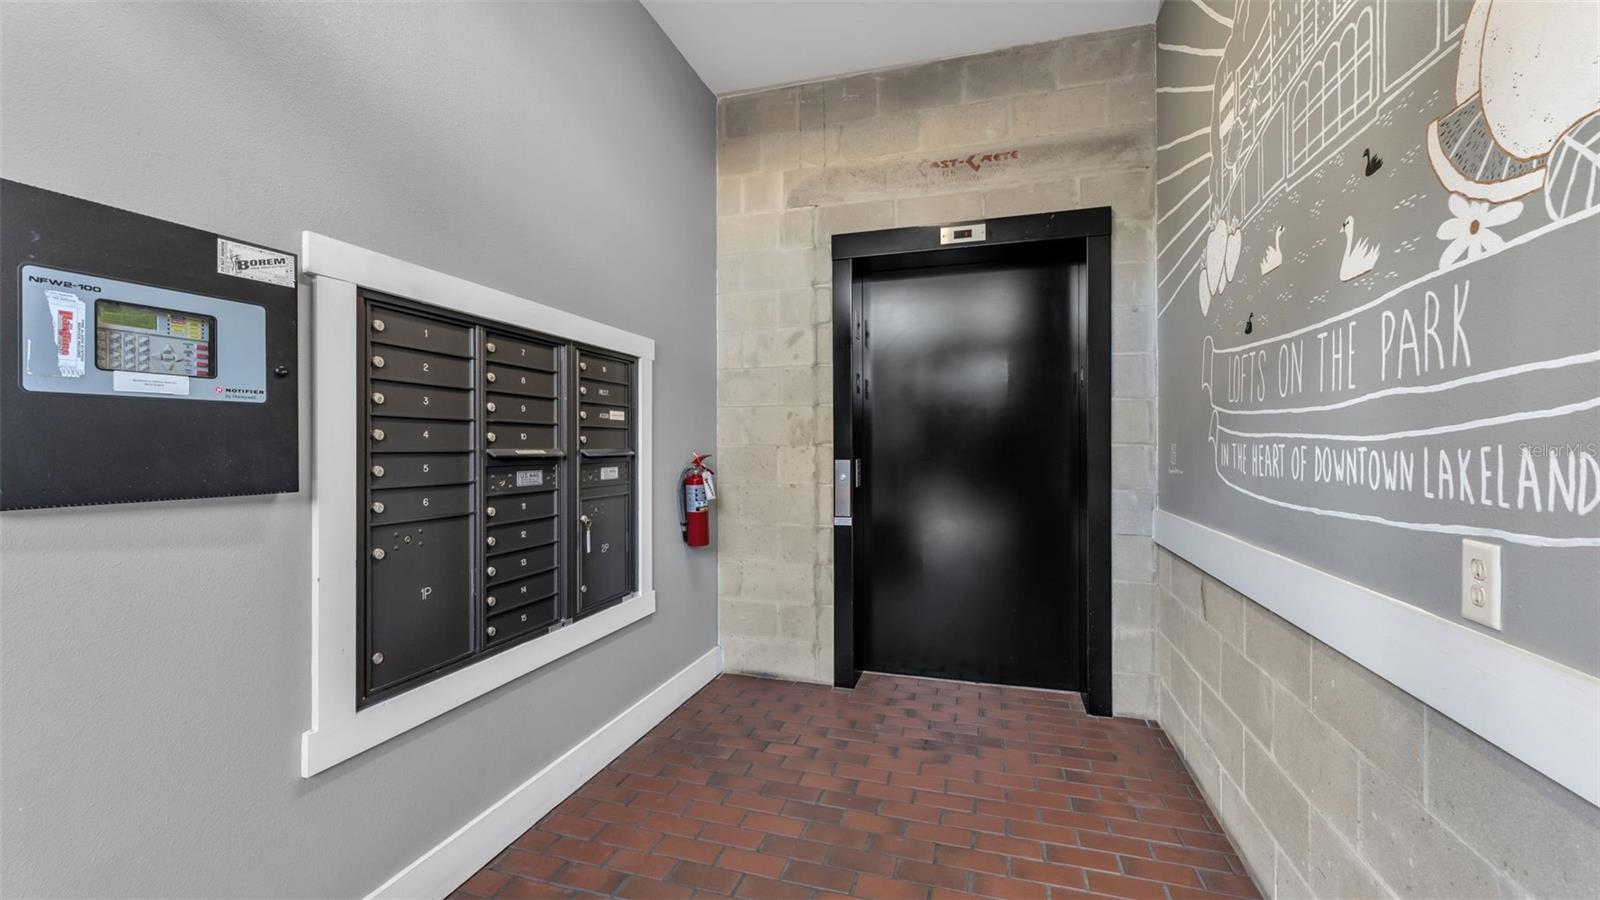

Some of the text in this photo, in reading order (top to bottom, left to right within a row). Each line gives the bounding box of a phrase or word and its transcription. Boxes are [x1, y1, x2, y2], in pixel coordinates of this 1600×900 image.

[236, 257, 286, 271] BOREM
[28, 275, 102, 293] NFW2-100
[1227, 279, 1472, 403] LOFTS ON THE PARK
[422, 362, 429, 372] 2
[422, 396, 429, 406] 3
[520, 404, 526, 413] 9
[422, 430, 429, 439] 4
[520, 432, 527, 441] 10
[422, 464, 429, 473] 5
[1221, 443, 1229, 467] IN
[1232, 443, 1247, 475] THE
[1252, 443, 1286, 479] HEART
[1291, 445, 1307, 482] OF
[1314, 446, 1414, 492] DOWNTOWN
[1423, 445, 1600, 516] LAKELAND
[422, 498, 429, 507] 6
[520, 530, 527, 538] 12
[601, 542, 610, 553] 2P
[520, 558, 527, 567] 13
[420, 587, 432, 600] 1P
[520, 613, 527, 622] 15
